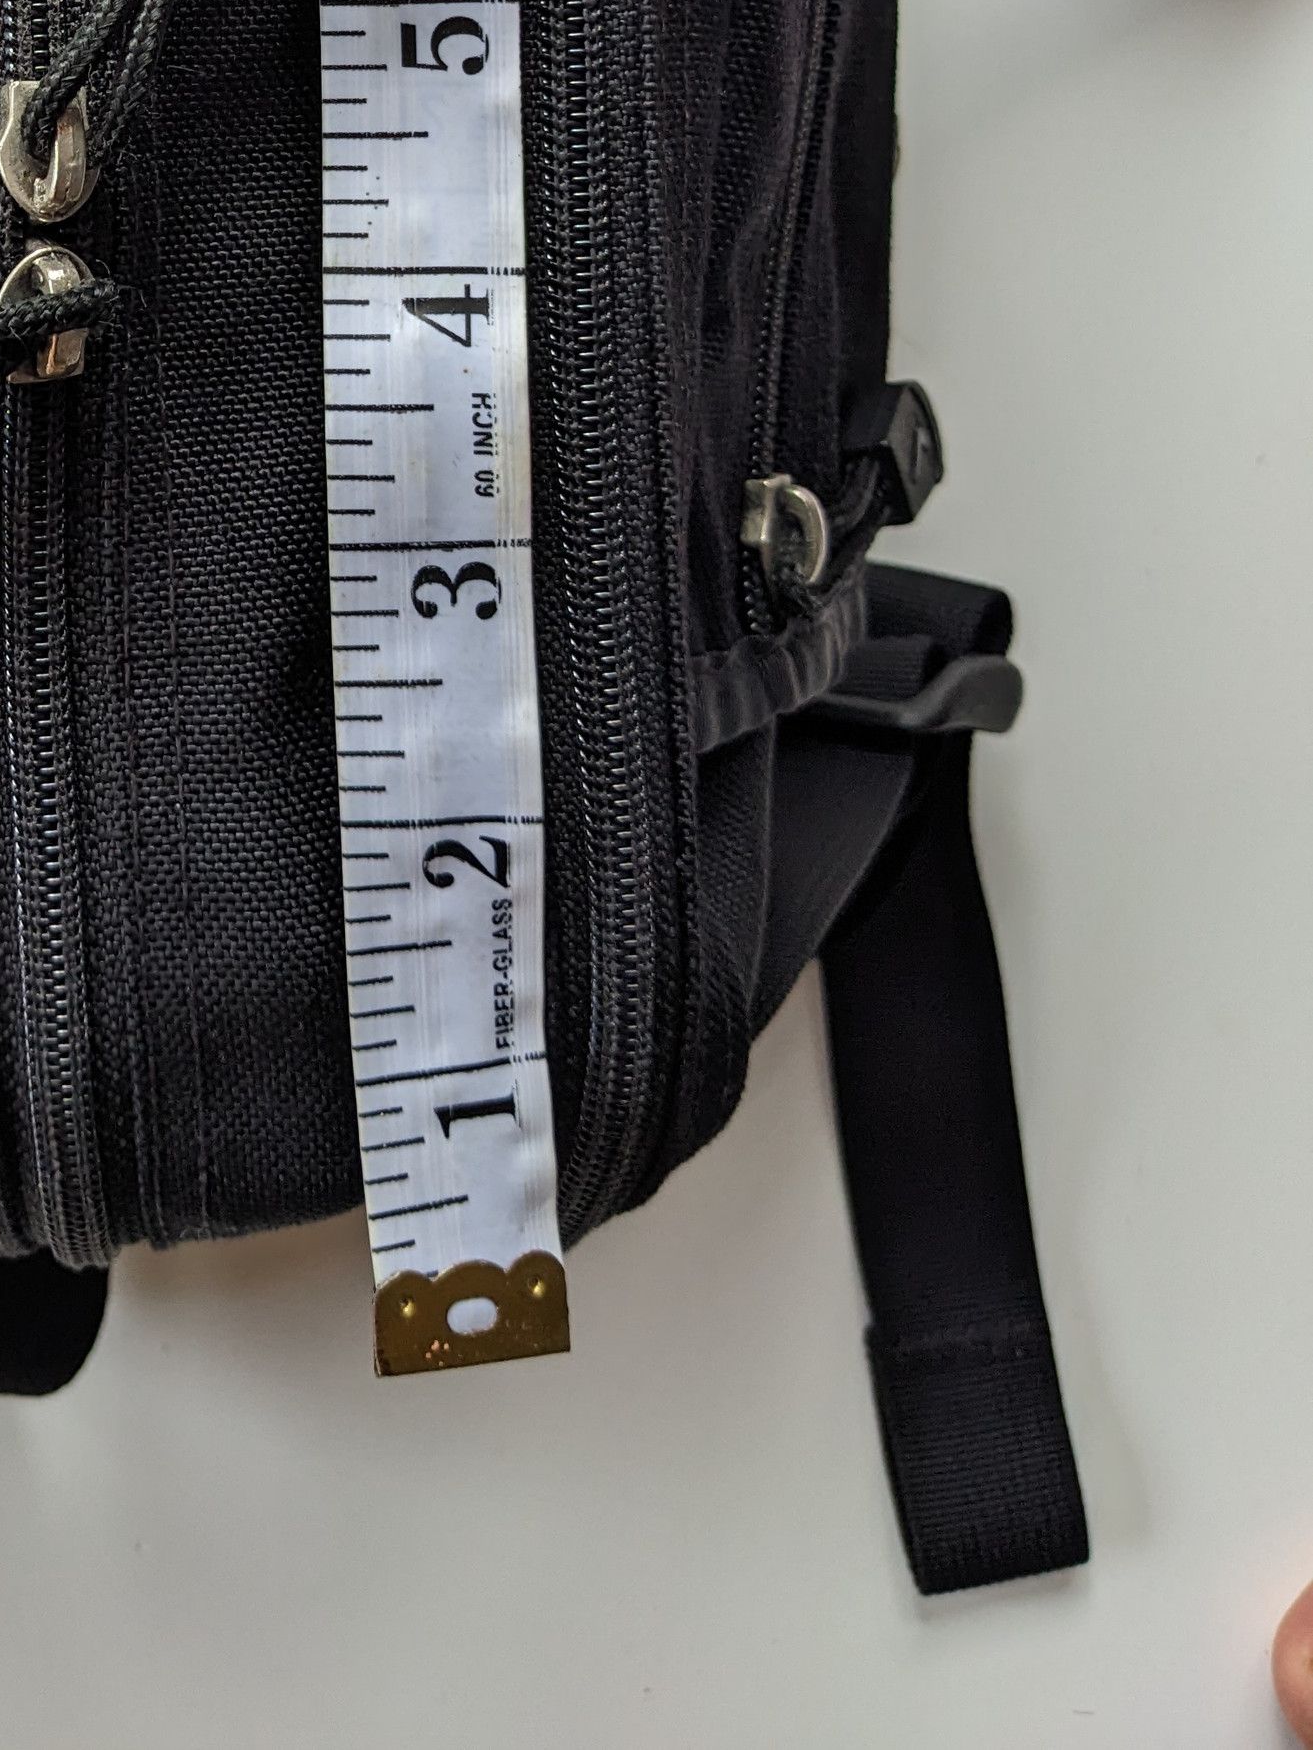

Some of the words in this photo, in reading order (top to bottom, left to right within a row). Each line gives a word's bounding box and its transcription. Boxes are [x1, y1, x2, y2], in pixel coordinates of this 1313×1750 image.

[400, 16, 490, 76] 5
[402, 283, 496, 347] 4
[471, 392, 497, 456] INCH
[473, 470, 500, 499] 60
[411, 561, 502, 620] 3
[422, 835, 510, 889] 2
[491, 898, 516, 1050] FIBER-GLASS
[433, 1079, 520, 1139] 1
